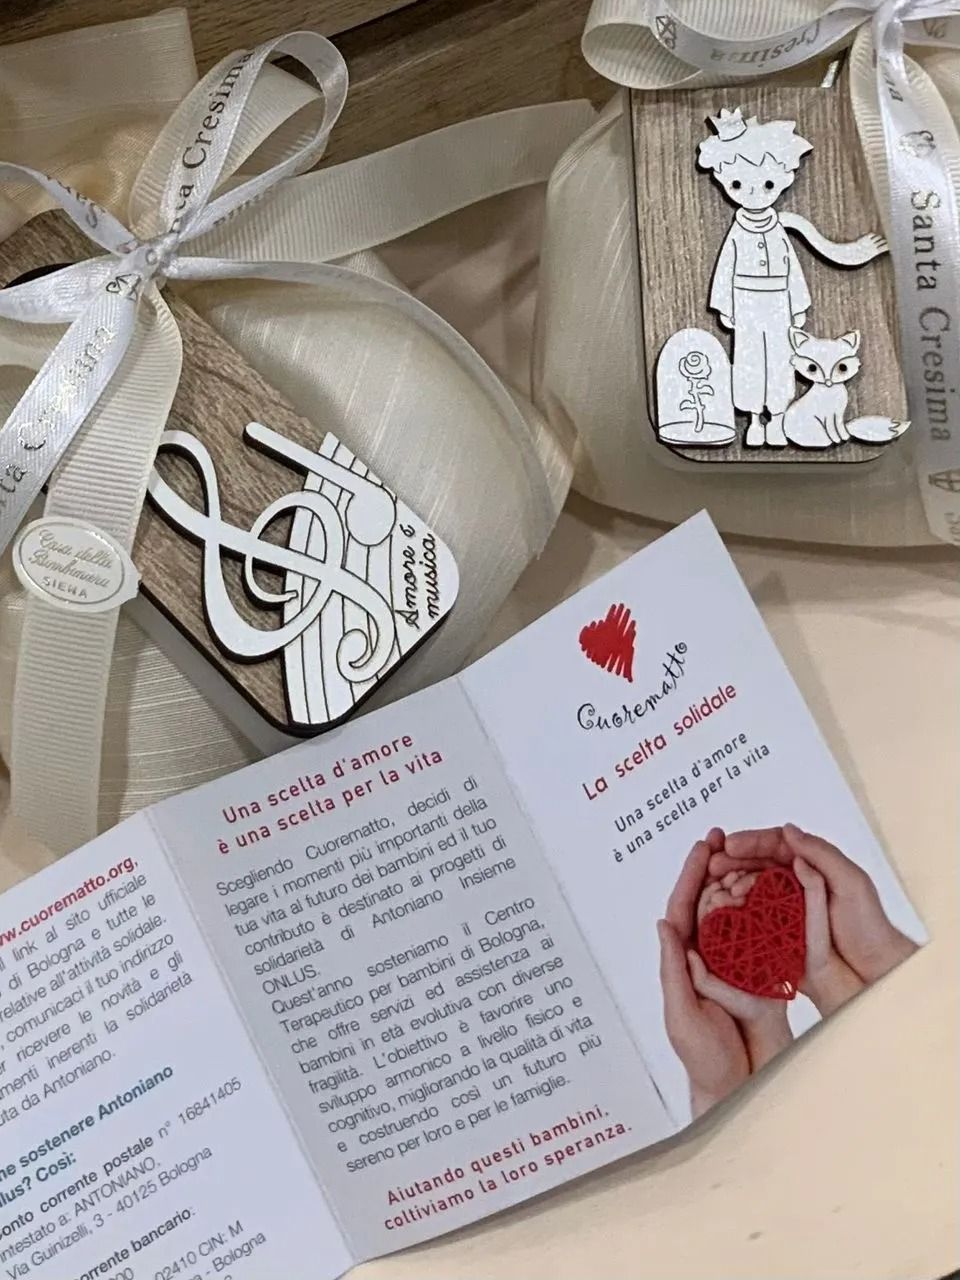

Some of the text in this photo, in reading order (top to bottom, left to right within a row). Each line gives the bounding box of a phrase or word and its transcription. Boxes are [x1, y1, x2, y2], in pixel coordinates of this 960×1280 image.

[182, 50, 254, 170] Cresima
[909, 190, 956, 443] Santa Cresima
[41, 575, 88, 599] SIENA
[395, 545, 420, 630] Amore
[419, 533, 440, 619] musica
[577, 641, 688, 730] Cuorematto
[222, 735, 413, 824] Una scelta d'amore
[581, 684, 736, 801] La scelta solidale
[613, 732, 748, 833] Una scelta d'amore
[215, 774, 479, 896] Scegliendo Cuorematto, decidi di
[234, 825, 271, 848] una
[276, 797, 336, 831] scelta
[341, 779, 373, 806] per
[378, 769, 400, 786] la
[404, 750, 443, 774] vita
[625, 829, 653, 854] una
[655, 796, 698, 832] scelta
[699, 775, 723, 803] per
[724, 764, 741, 780] la
[742, 744, 770, 767] vita
[48, 945, 112, 992] all'attività
[253, 857, 517, 976] solidarietà di Antoniano Insieme
[270, 897, 536, 1016] Quest'anno sosteniamo il Centro
[5, 985, 85, 1043] comunicaci
[83, 978, 95, 995] il
[94, 968, 119, 989] tuo
[118, 933, 174, 974] indirizzo
[44, 1032, 98, 1070] inerenti
[103, 1019, 120, 1035] la
[125, 970, 195, 1021] solidarietà
[261, 963, 321, 995] ONLUS.
[278, 919, 546, 1034] Terapeutico per bambini di Bologna,
[307, 1064, 364, 1094] fragilità.
[372, 1030, 448, 1070] L'obiettivo
[478, 993, 534, 1024] favorire
[543, 976, 574, 996] uno
[327, 1015, 594, 1133] cognitivo, migliorando la qualità di vita
[18, 1115, 95, 1168] sostenere
[98, 1066, 174, 1121] Antoniano
[20, 1092, 41, 1111] da
[39, 1171, 98, 1213] corrente
[101, 1136, 154, 1177] postale
[177, 1076, 242, 1124] 16841405
[384, 1123, 632, 1230] coltiviamo la loro speranza.
[387, 1103, 609, 1206] Aiutando questi bambini.
[6, 1261, 30, 1280] Via
[116, 1178, 158, 1213] 40125
[156, 1147, 213, 1187] Bologna
[78, 1248, 131, 1280] orrente
